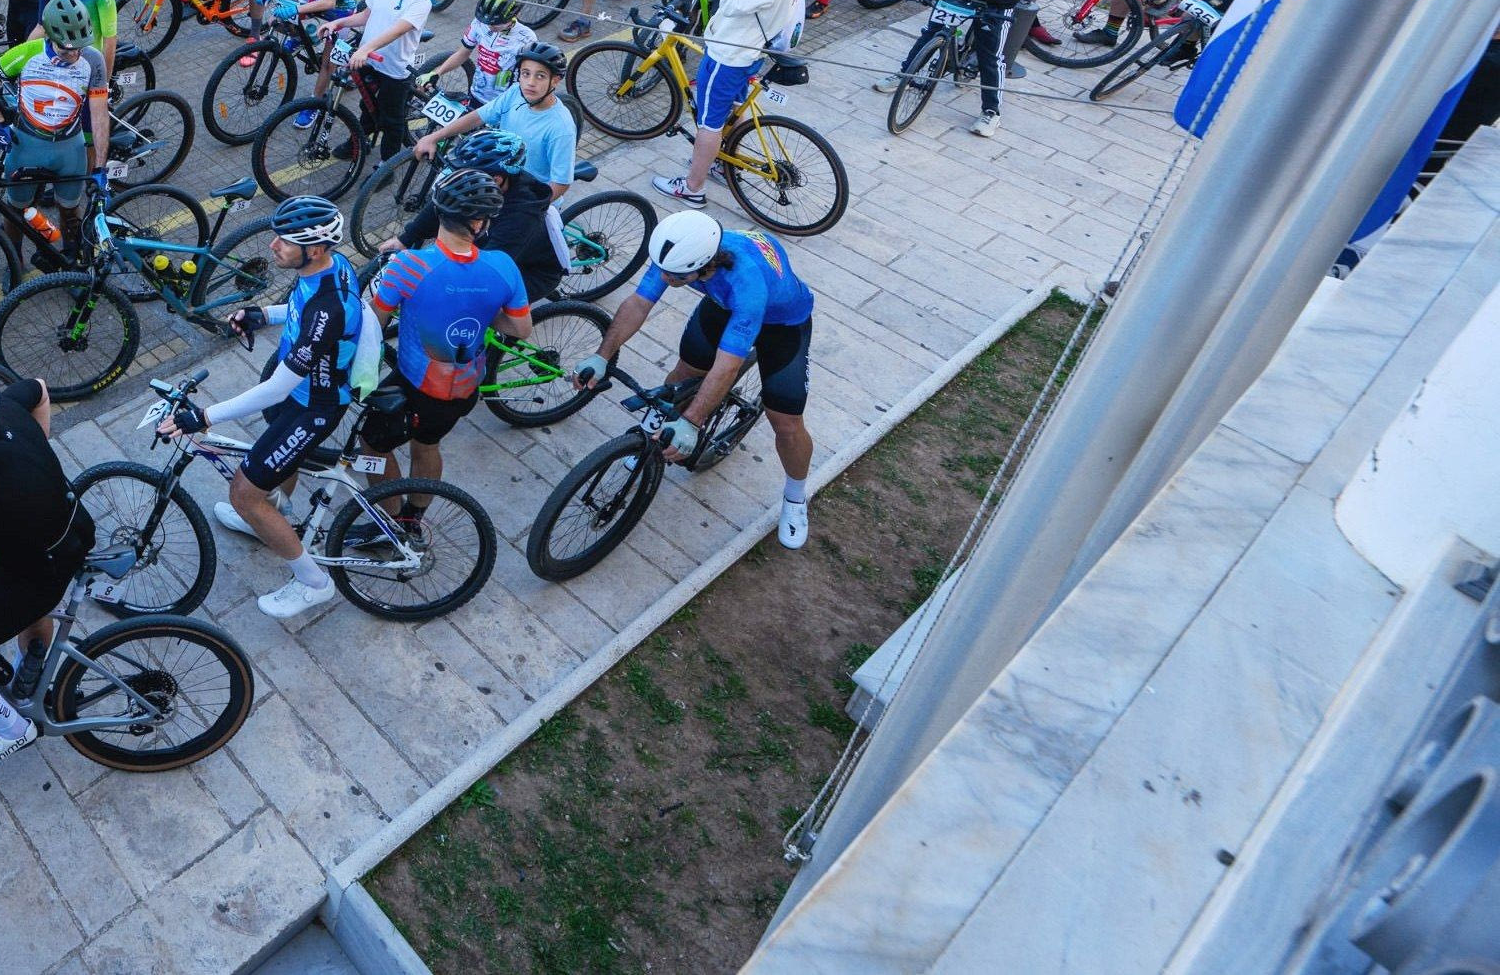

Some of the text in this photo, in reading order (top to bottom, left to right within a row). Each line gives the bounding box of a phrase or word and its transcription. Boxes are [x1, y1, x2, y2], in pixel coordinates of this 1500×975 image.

[937, 9, 971, 26] 217
[1184, 2, 1214, 23] 135
[426, 100, 456, 122] 209
[312, 310, 329, 342] SYNKA
[451, 328, 476, 340] ΔΕΗ
[263, 426, 307, 470] TALOS
[365, 461, 376, 472] 21
[104, 586, 111, 596] 8
